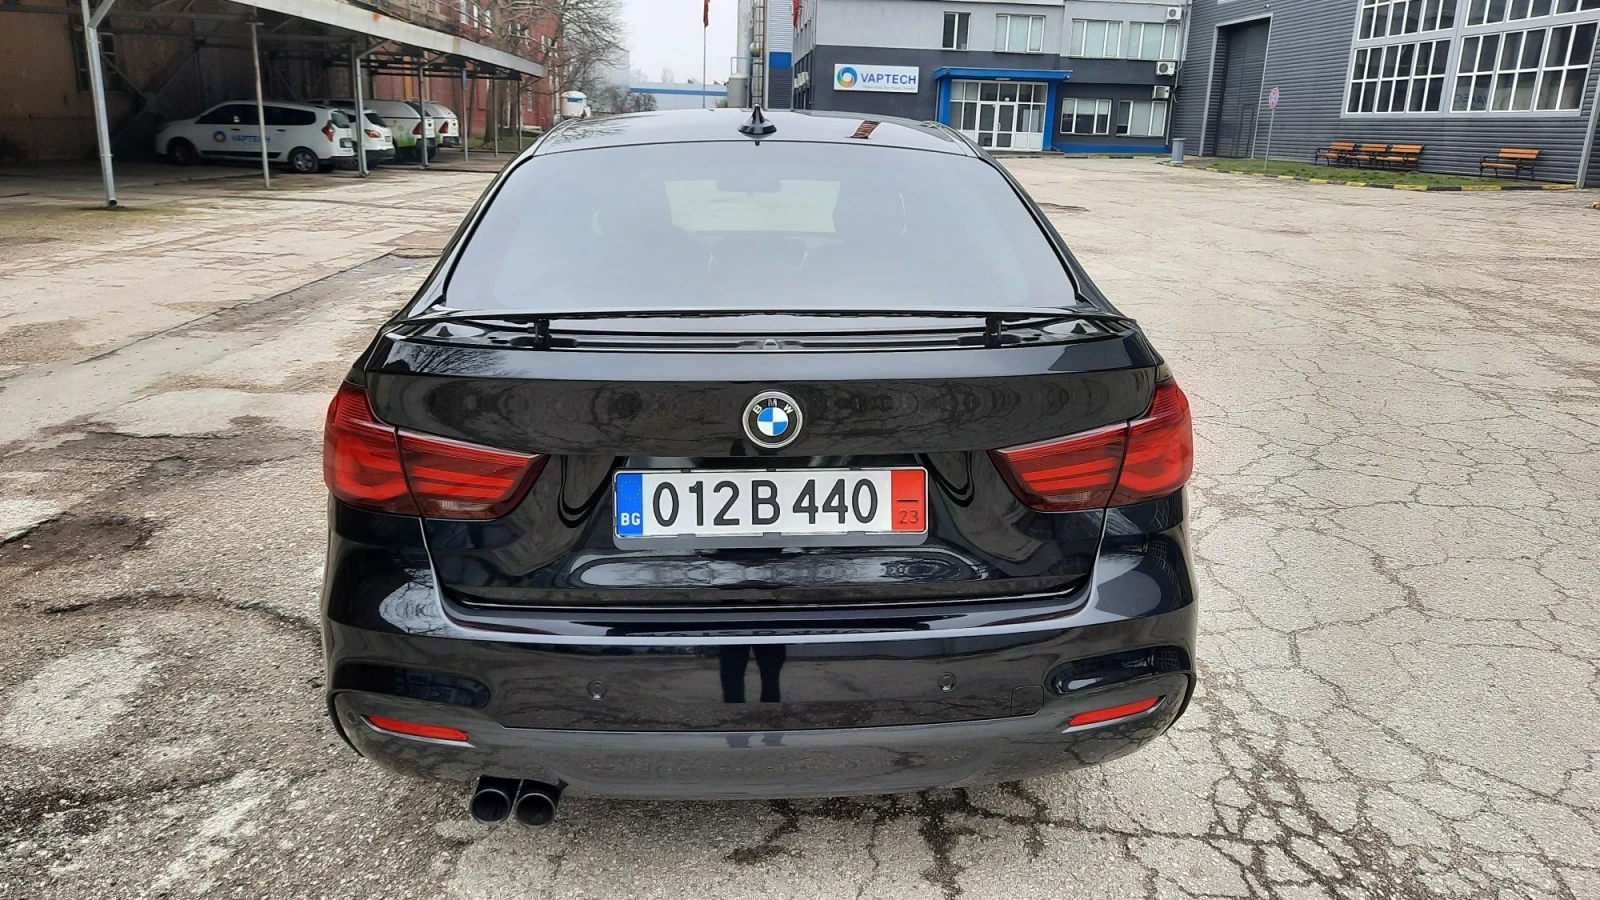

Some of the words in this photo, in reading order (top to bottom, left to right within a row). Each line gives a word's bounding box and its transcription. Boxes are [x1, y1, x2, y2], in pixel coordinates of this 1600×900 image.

[861, 73, 917, 84] VAPTECH
[752, 398, 794, 415] BMW
[620, 512, 641, 527] BG
[899, 508, 919, 524] 23
